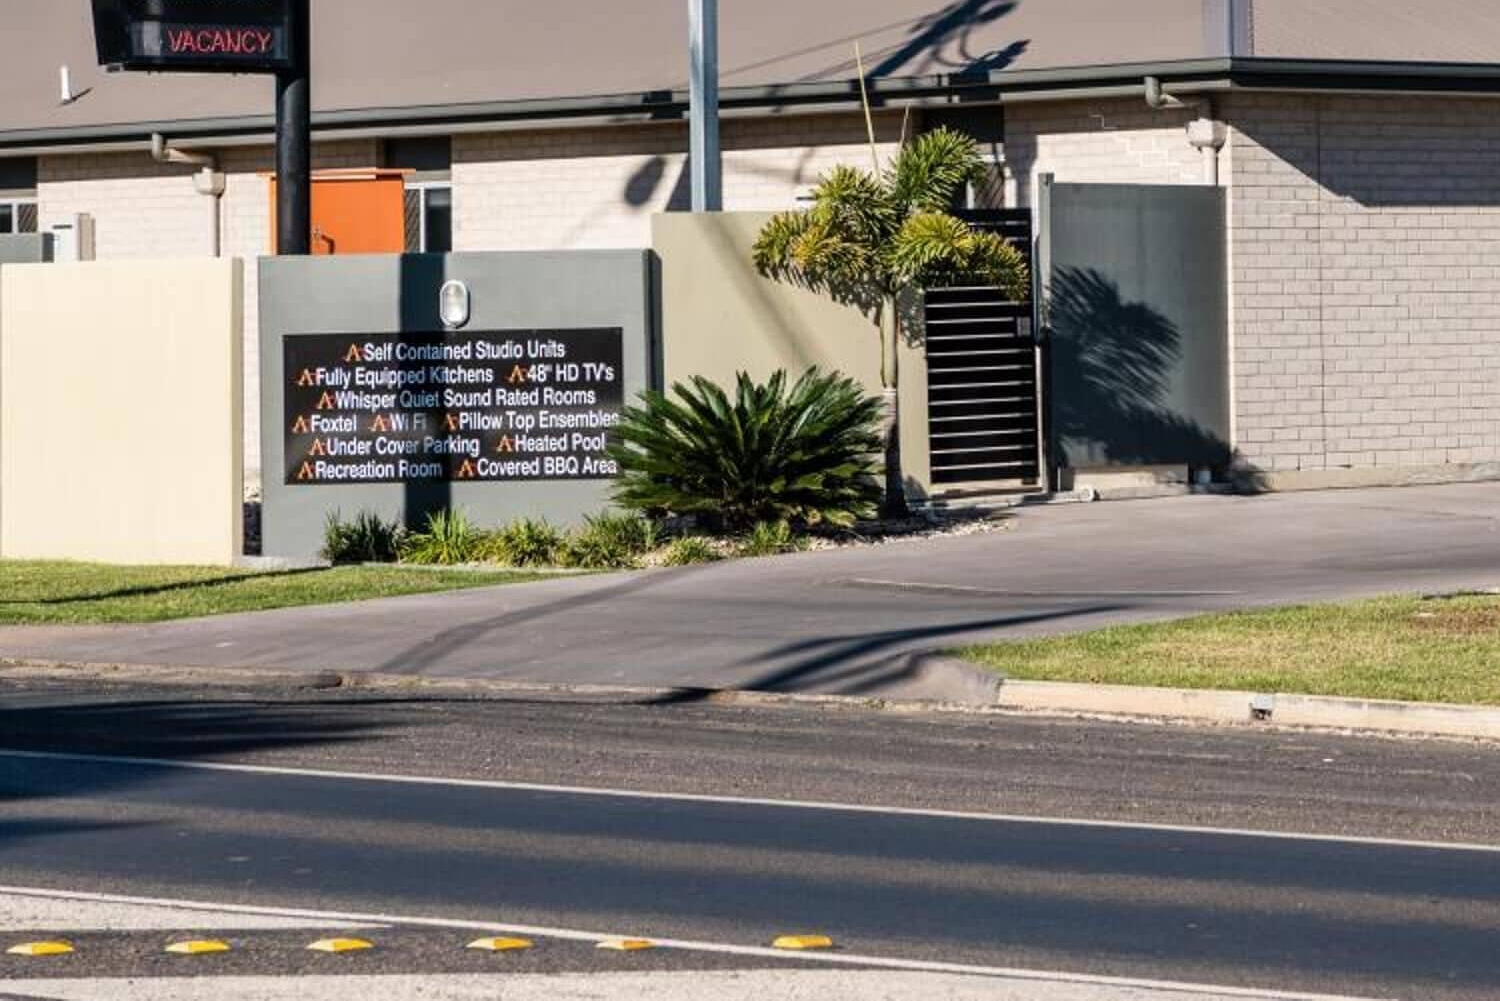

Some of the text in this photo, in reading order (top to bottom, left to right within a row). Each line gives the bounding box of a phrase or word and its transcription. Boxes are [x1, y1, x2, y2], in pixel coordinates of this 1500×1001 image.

[167, 28, 272, 54] VACANCY
[364, 342, 393, 361] Self
[395, 341, 471, 360] Contained
[475, 340, 523, 359] Studio
[527, 339, 566, 358] Units
[315, 366, 351, 389] Fully
[355, 366, 426, 389] Equipped
[430, 365, 494, 383] Kitchens
[555, 363, 579, 381] HD
[583, 362, 615, 381] TV's
[336, 390, 396, 413] Whisper
[401, 390, 440, 409] Quiet
[443, 388, 491, 407] Sound
[495, 388, 539, 406] Rated
[543, 386, 596, 405] Rooms
[311, 414, 357, 432] Foxtel
[459, 411, 503, 430] Pillow
[505, 410, 535, 433] Top
[539, 410, 619, 429] Ensembles
[327, 437, 372, 455] Under
[375, 436, 419, 455] Cover
[424, 435, 480, 457] Parking
[515, 433, 567, 452] Heated
[572, 432, 606, 450] Pool
[315, 460, 395, 479] Recreation
[399, 459, 442, 477] Room
[477, 457, 540, 476] Covered
[543, 456, 579, 475] BBQ
[582, 456, 617, 474] Area
